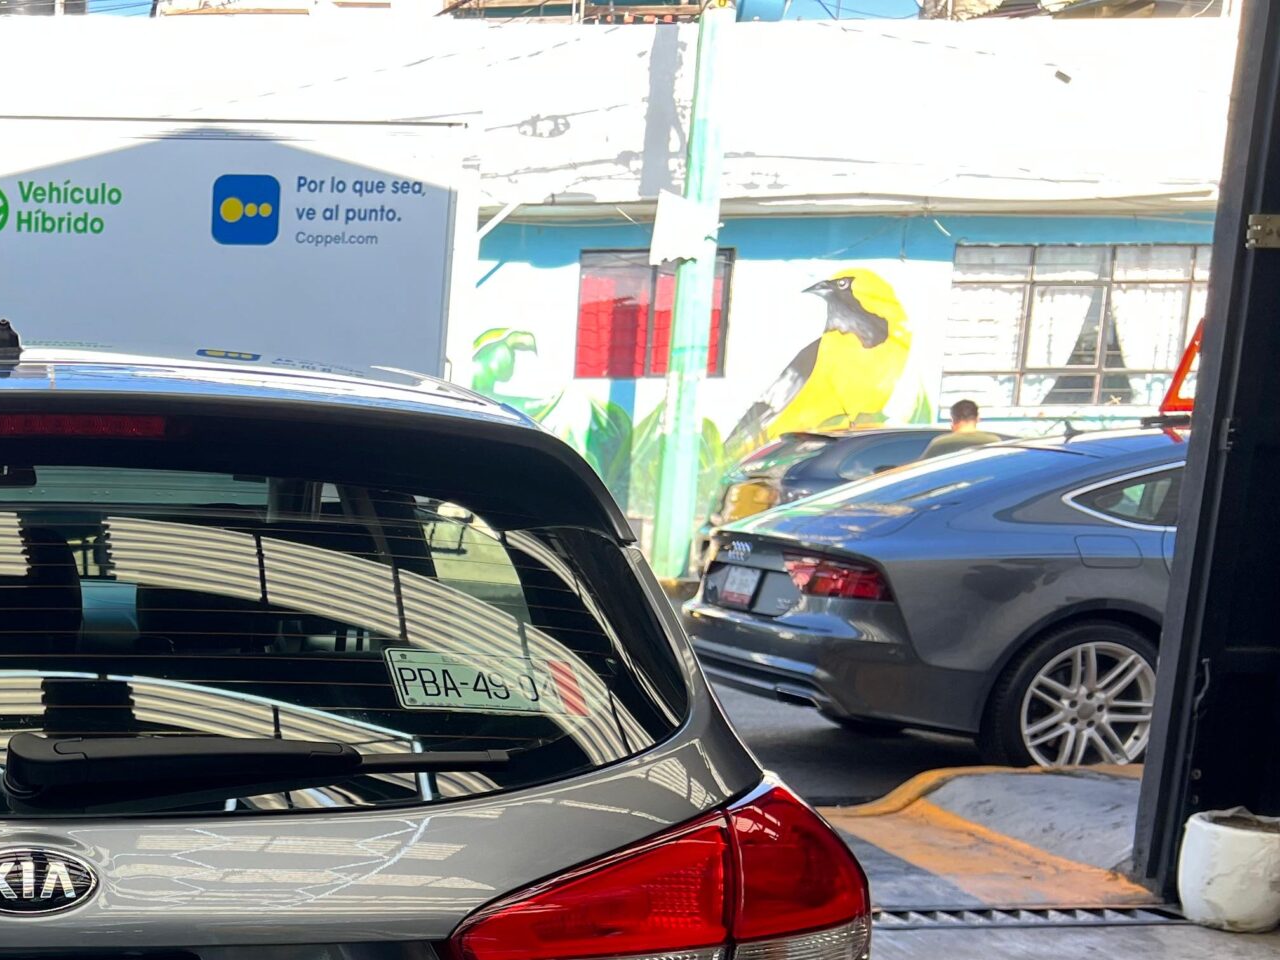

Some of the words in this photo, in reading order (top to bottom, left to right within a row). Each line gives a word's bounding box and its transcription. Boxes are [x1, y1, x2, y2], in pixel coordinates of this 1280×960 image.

[17, 179, 123, 205] Vehículo
[296, 176, 325, 193] Por
[330, 176, 346, 193] lo
[352, 179, 386, 198] que
[391, 180, 426, 197] sea,
[16, 208, 105, 234] Híbrido
[296, 207, 316, 220] ve
[322, 204, 339, 221] al
[345, 205, 402, 225] punto.
[295, 231, 379, 247] Coppel.com
